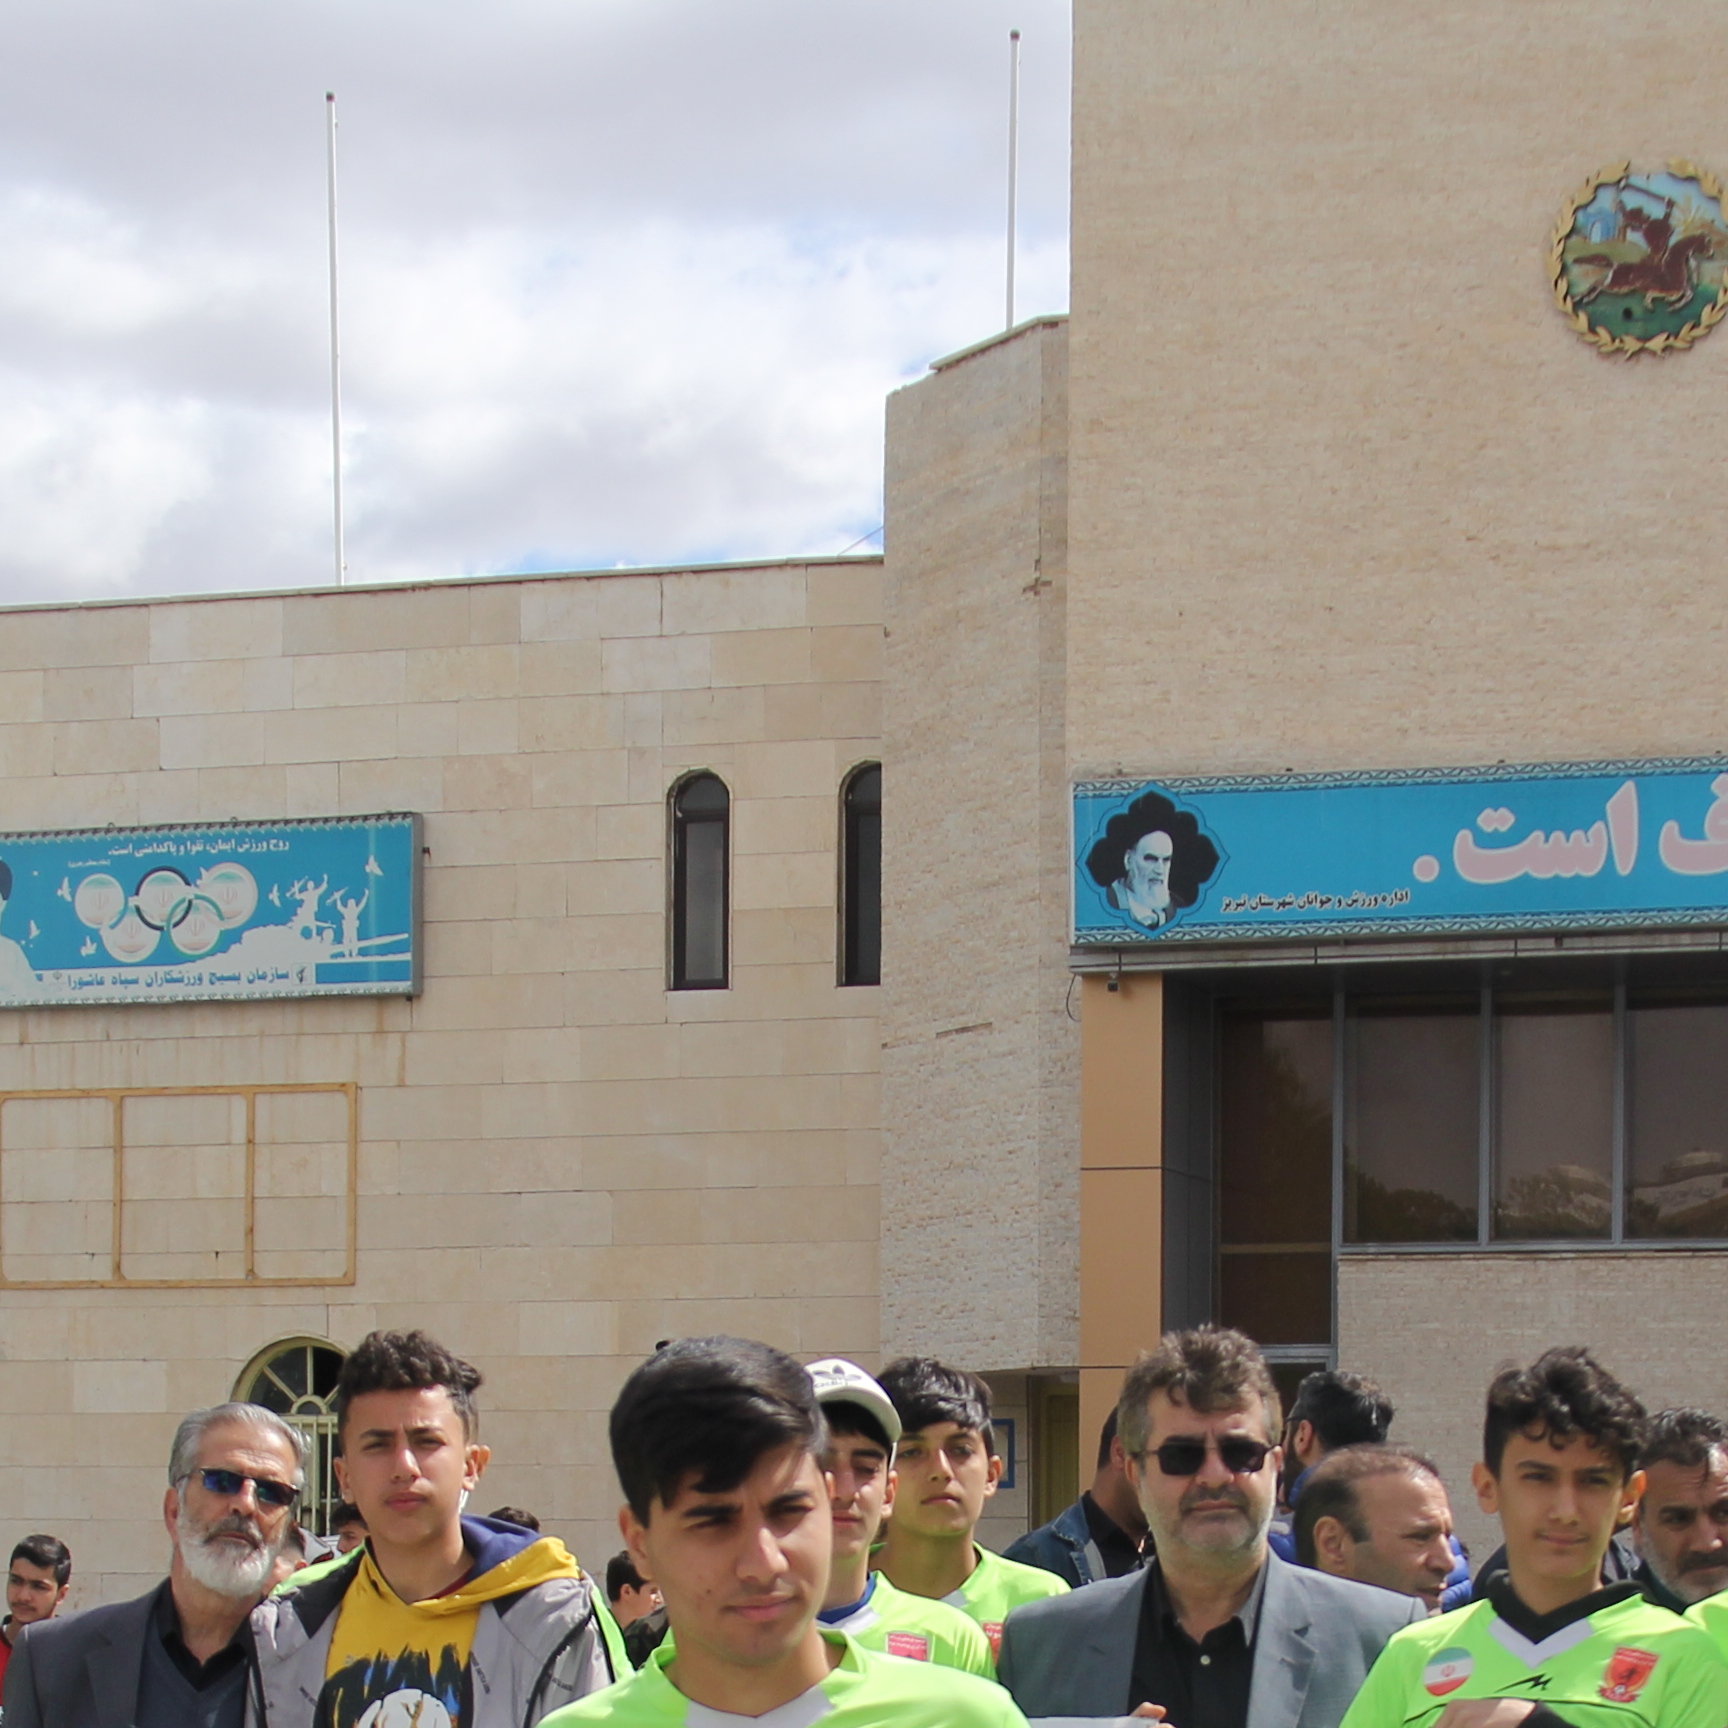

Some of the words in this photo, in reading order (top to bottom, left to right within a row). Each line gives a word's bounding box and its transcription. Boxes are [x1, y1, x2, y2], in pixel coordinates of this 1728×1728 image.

[1412, 780, 1638, 885] است.
[236, 840, 268, 852] ورزش
[1221, 894, 1247, 913] تبریز
[1249, 893, 1295, 911] شهرستان
[1296, 891, 1334, 910] جوانان
[1335, 896, 1343, 909] و
[1345, 890, 1379, 909] ورزش
[1380, 888, 1411, 906] اداره
[67, 973, 105, 990] عاشورا
[145, 968, 204, 988] ورزشکاران
[208, 970, 241, 986] بسیج
[247, 966, 290, 984] سازمان
